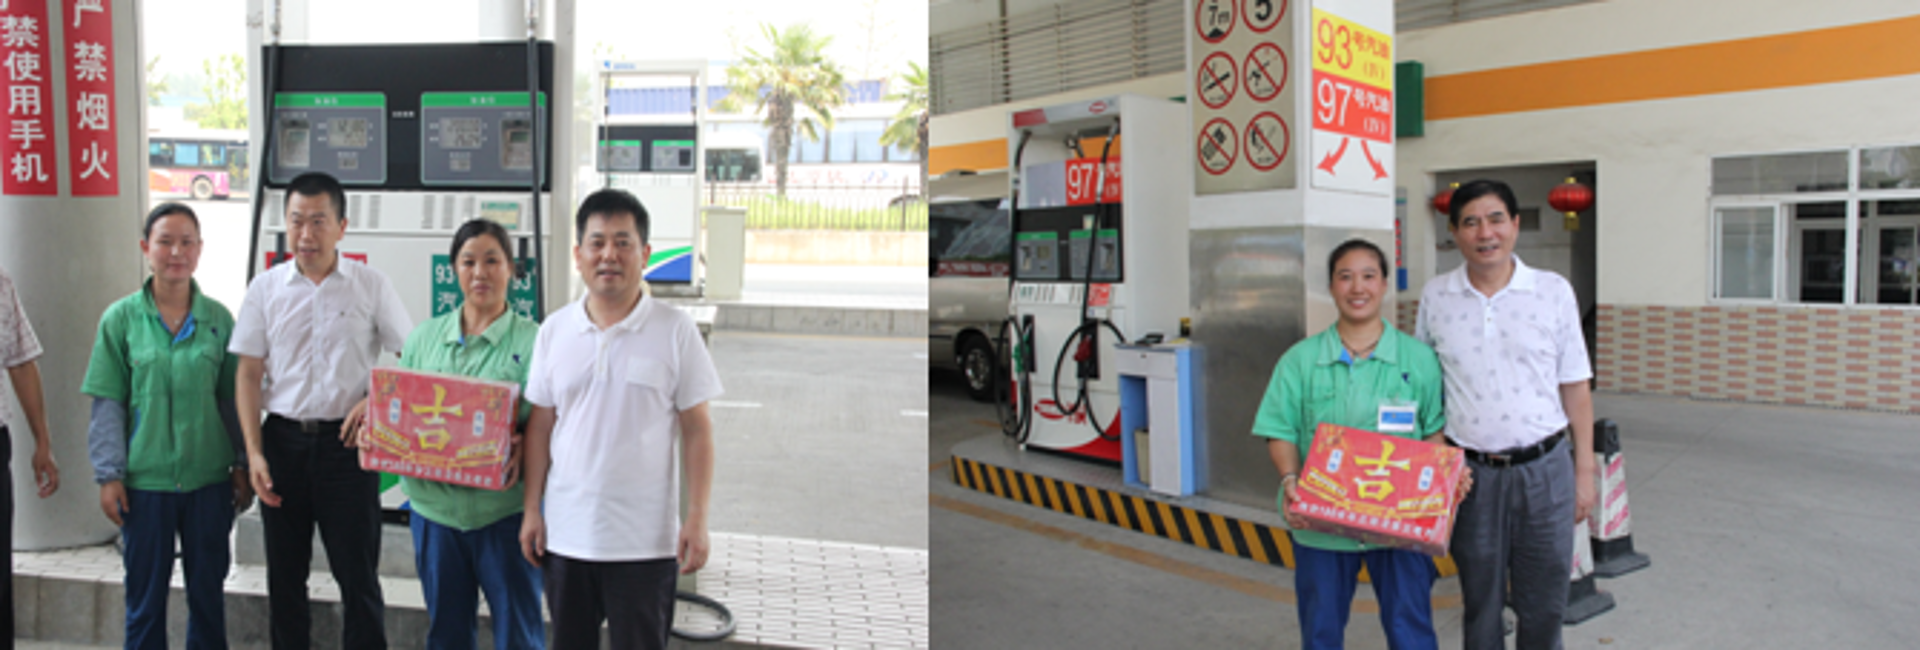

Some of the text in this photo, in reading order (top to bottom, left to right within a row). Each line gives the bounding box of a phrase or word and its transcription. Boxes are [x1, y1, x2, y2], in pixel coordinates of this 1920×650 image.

[0, 0, 49, 181] 禁使用手机
[72, 0, 111, 179] 严禁烟火
[410, 384, 464, 451] 吉
[1353, 440, 1411, 502] 吉
